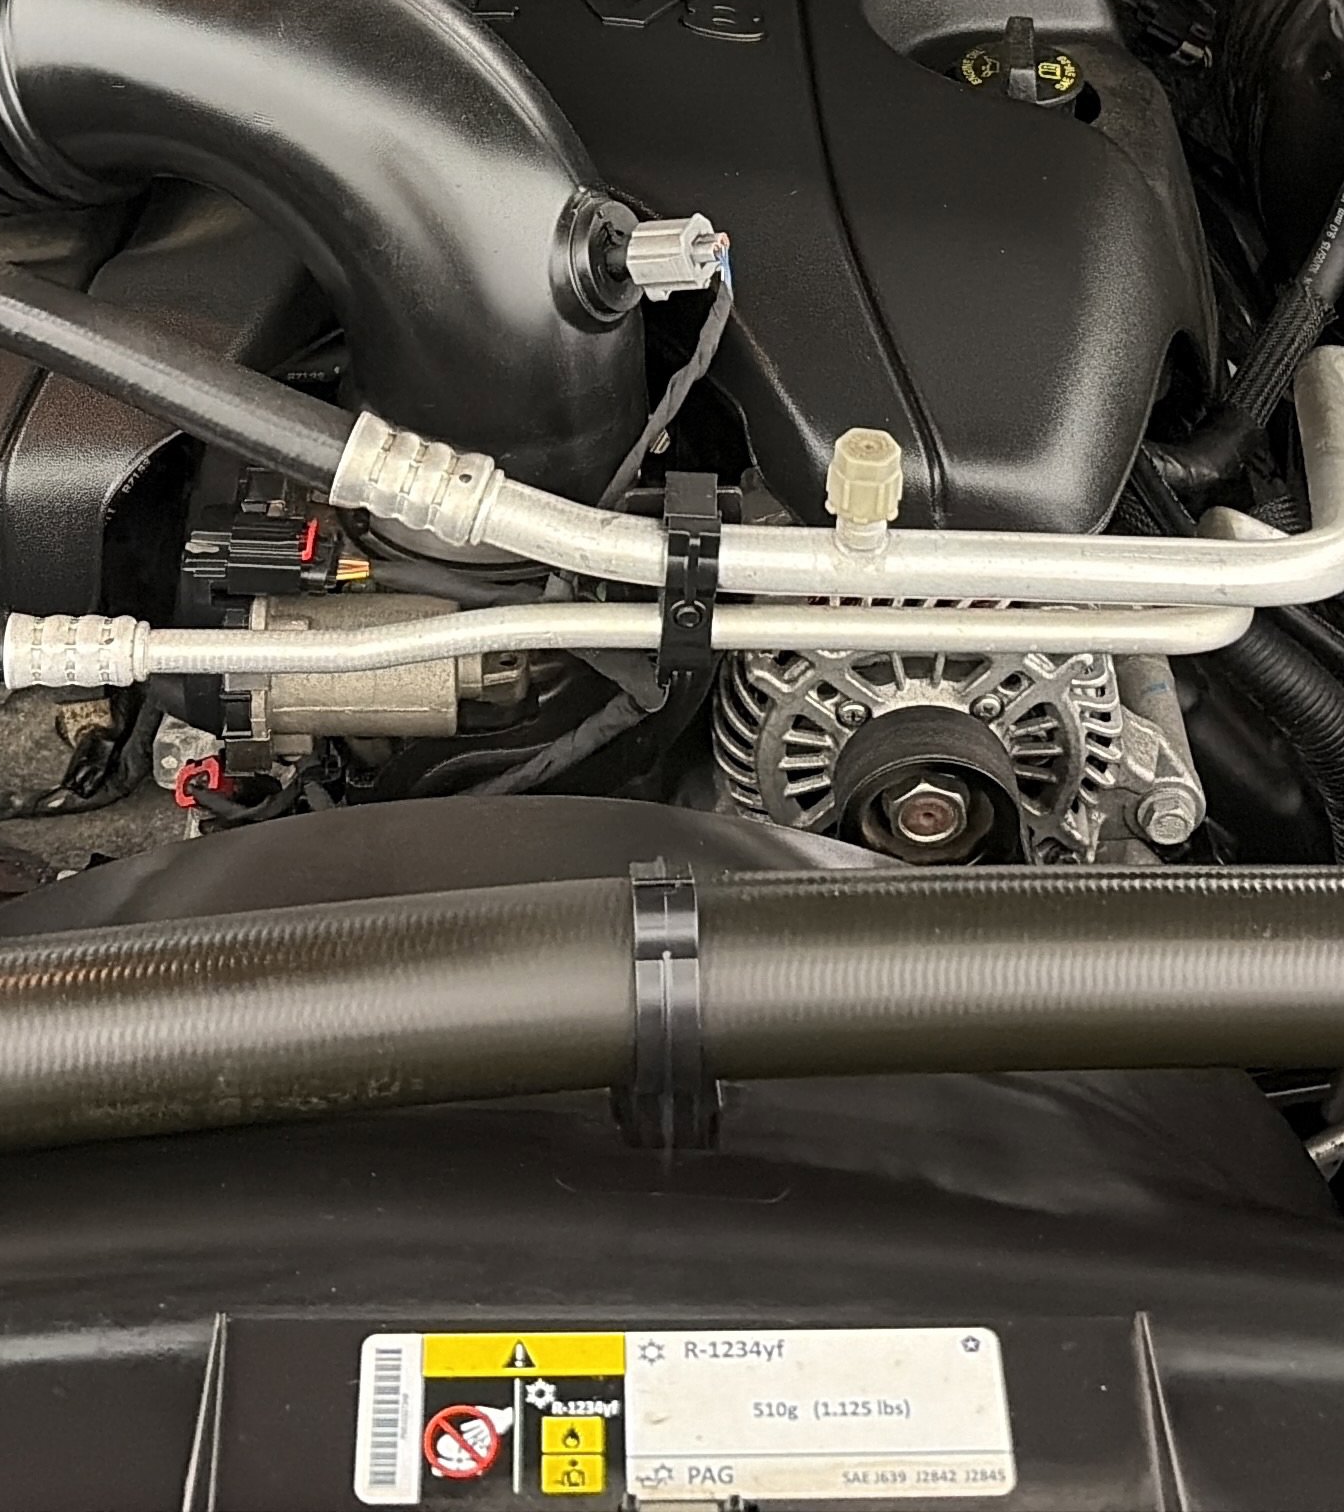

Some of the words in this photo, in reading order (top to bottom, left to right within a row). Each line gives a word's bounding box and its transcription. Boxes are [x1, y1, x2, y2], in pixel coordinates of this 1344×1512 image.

[684, 1340, 785, 1363] R-1234yf
[552, 1400, 620, 1418] R-1234yf
[753, 1401, 799, 1420] 510g
[813, 1399, 872, 1421] (1.125
[877, 1398, 911, 1420] lbs)
[687, 1466, 735, 1486] PAG
[842, 1471, 871, 1484] SAE
[873, 1470, 907, 1485] J639
[915, 1469, 957, 1485] J2842
